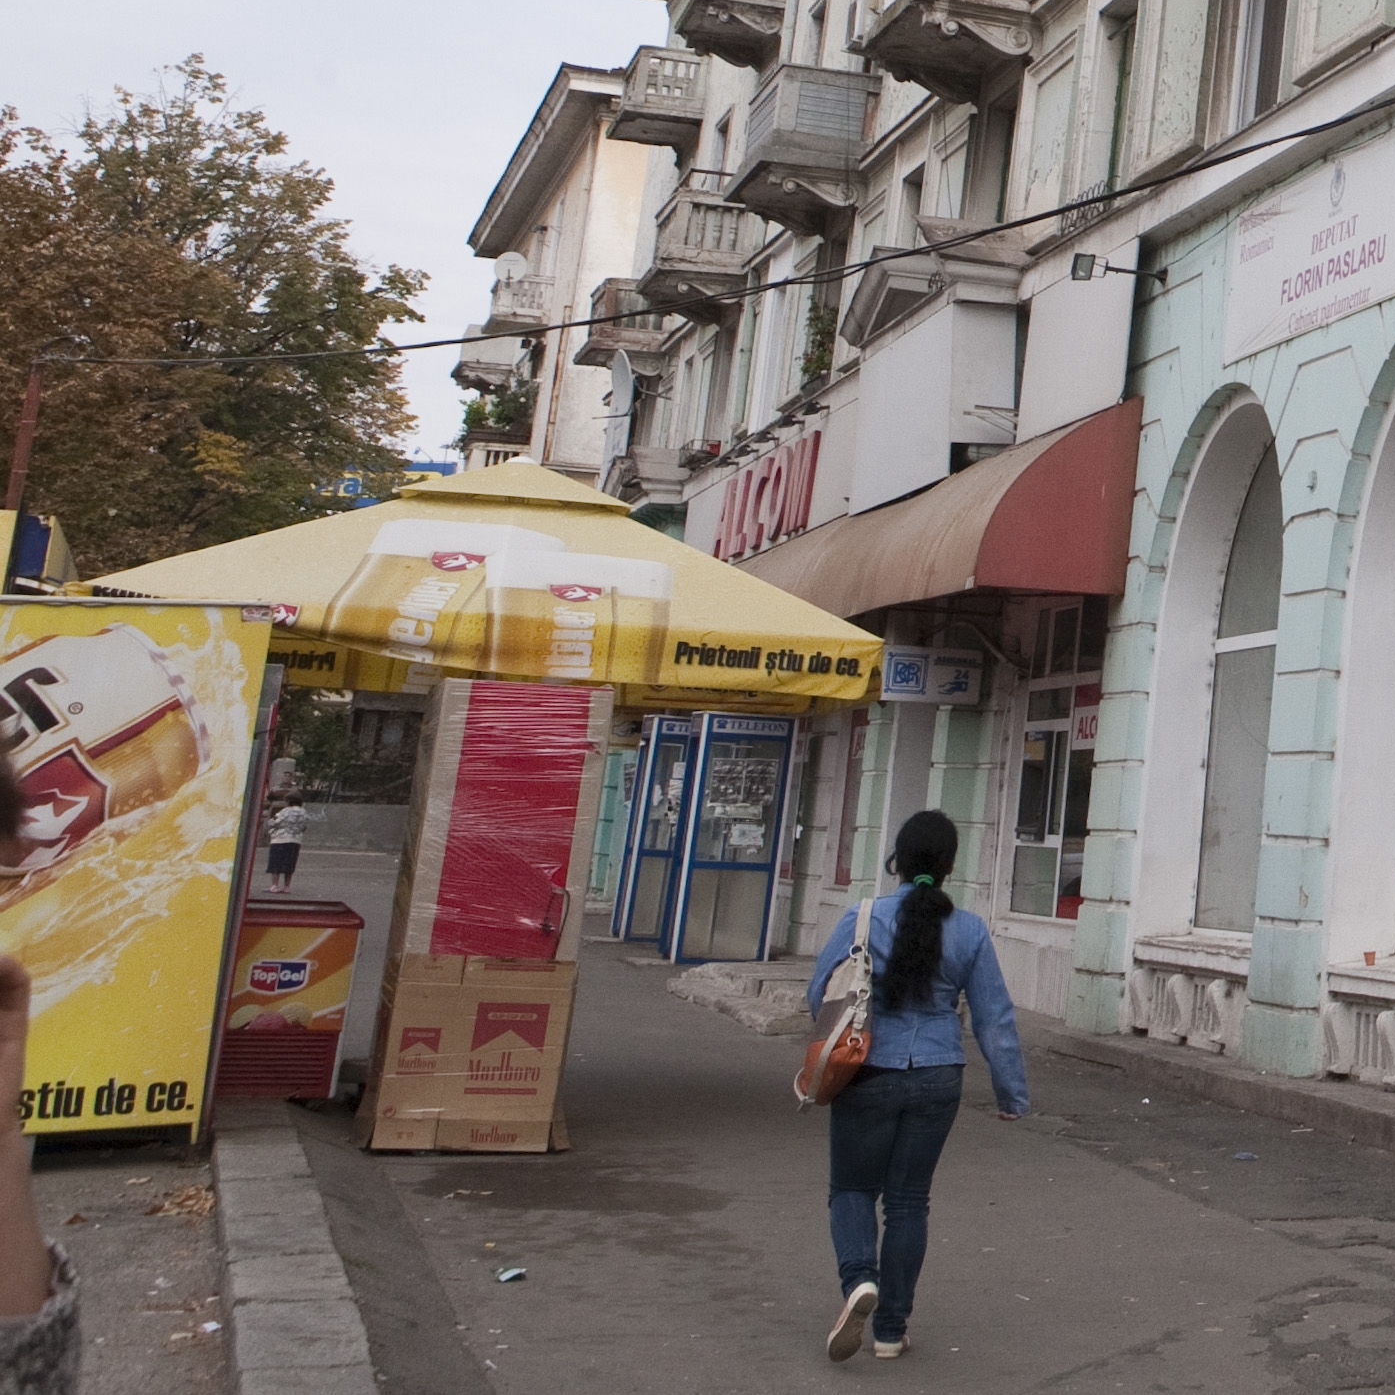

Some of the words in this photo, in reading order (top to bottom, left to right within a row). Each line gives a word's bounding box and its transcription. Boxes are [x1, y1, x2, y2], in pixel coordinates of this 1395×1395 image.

[1310, 214, 1360, 256] DEPUTAT
[1280, 264, 1324, 307] FLORIN
[1326, 234, 1387, 287] PASLARU
[713, 430, 822, 562] ALCOM
[673, 641, 762, 669] Prietenii
[808, 651, 832, 674] de
[835, 656, 863, 678] ce.
[954, 669, 970, 680] 24
[729, 719, 786, 733] TELEFON
[1076, 715, 1099, 741] ALC
[469, 1051, 541, 1083] Marlboro
[94, 1077, 137, 1117] de
[145, 1080, 195, 1113] ce.
